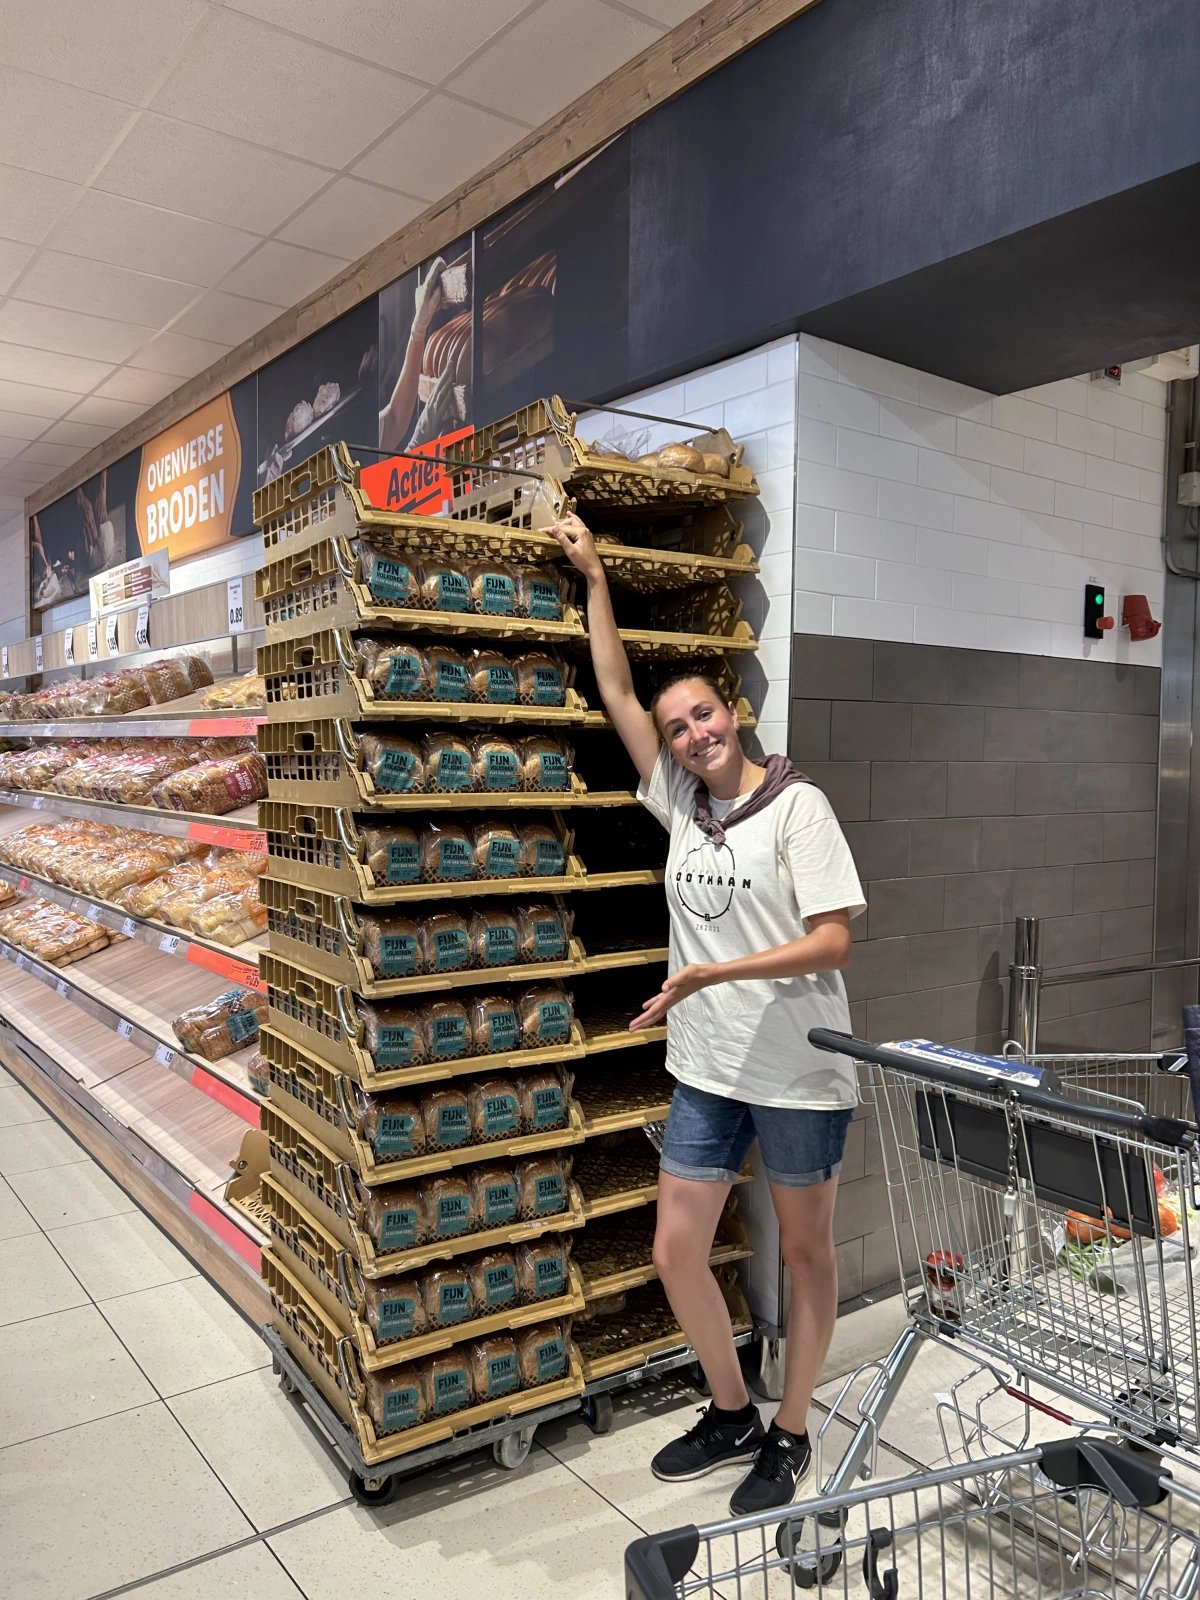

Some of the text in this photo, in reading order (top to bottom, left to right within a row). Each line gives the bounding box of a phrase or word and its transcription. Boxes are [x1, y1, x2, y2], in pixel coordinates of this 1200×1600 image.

[147, 423, 223, 492] OVENVERSE
[386, 443, 441, 507] Actie!
[146, 469, 224, 545] BRODEN
[377, 561, 399, 575] FIJN
[442, 576, 462, 587] FIJN
[486, 578, 505, 589] FIJN
[534, 585, 552, 596] FIJN
[230, 606, 242, 624] 0.89
[442, 665, 461, 677] FIJN
[490, 670, 508, 679] FIJN
[537, 672, 554, 680] FIJN
[386, 753, 407, 766] FIJN
[442, 754, 462, 764] FIJN
[490, 755, 509, 765] FIJN
[543, 756, 561, 765] FIJN
[392, 847, 412, 857] FIJN
[444, 844, 465, 854] FIJN
[492, 842, 511, 852] FIJN
[540, 843, 558, 853] FIJN
[669, 872, 752, 889] OOTHAAN
[538, 924, 555, 934] FIJN
[438, 933, 458, 945] FIJN
[488, 930, 508, 940] FIJN
[385, 939, 407, 950] FIJN
[543, 1006, 560, 1017] FIJN
[492, 1015, 512, 1026] FIJN
[437, 1021, 457, 1032] FIJN
[382, 1031, 404, 1040] FIJN
[536, 1091, 555, 1104] FIJN
[487, 1099, 507, 1112] FIJN
[442, 1110, 462, 1120] FIJN
[382, 1119, 404, 1130] FIJN
[539, 1179, 557, 1191] FIJN
[489, 1188, 508, 1200] FIJN
[441, 1200, 461, 1212] FIJN
[387, 1214, 408, 1225] FIJN
[538, 1261, 557, 1274] FIJN
[488, 1269, 508, 1283] FIJN
[444, 1288, 463, 1299] FIJN
[383, 1303, 405, 1315] FIJN
[539, 1344, 558, 1359] FIJN
[492, 1359, 510, 1374] FIJN
[438, 1375, 458, 1389] FIJN
[388, 1393, 409, 1407] FIJN
